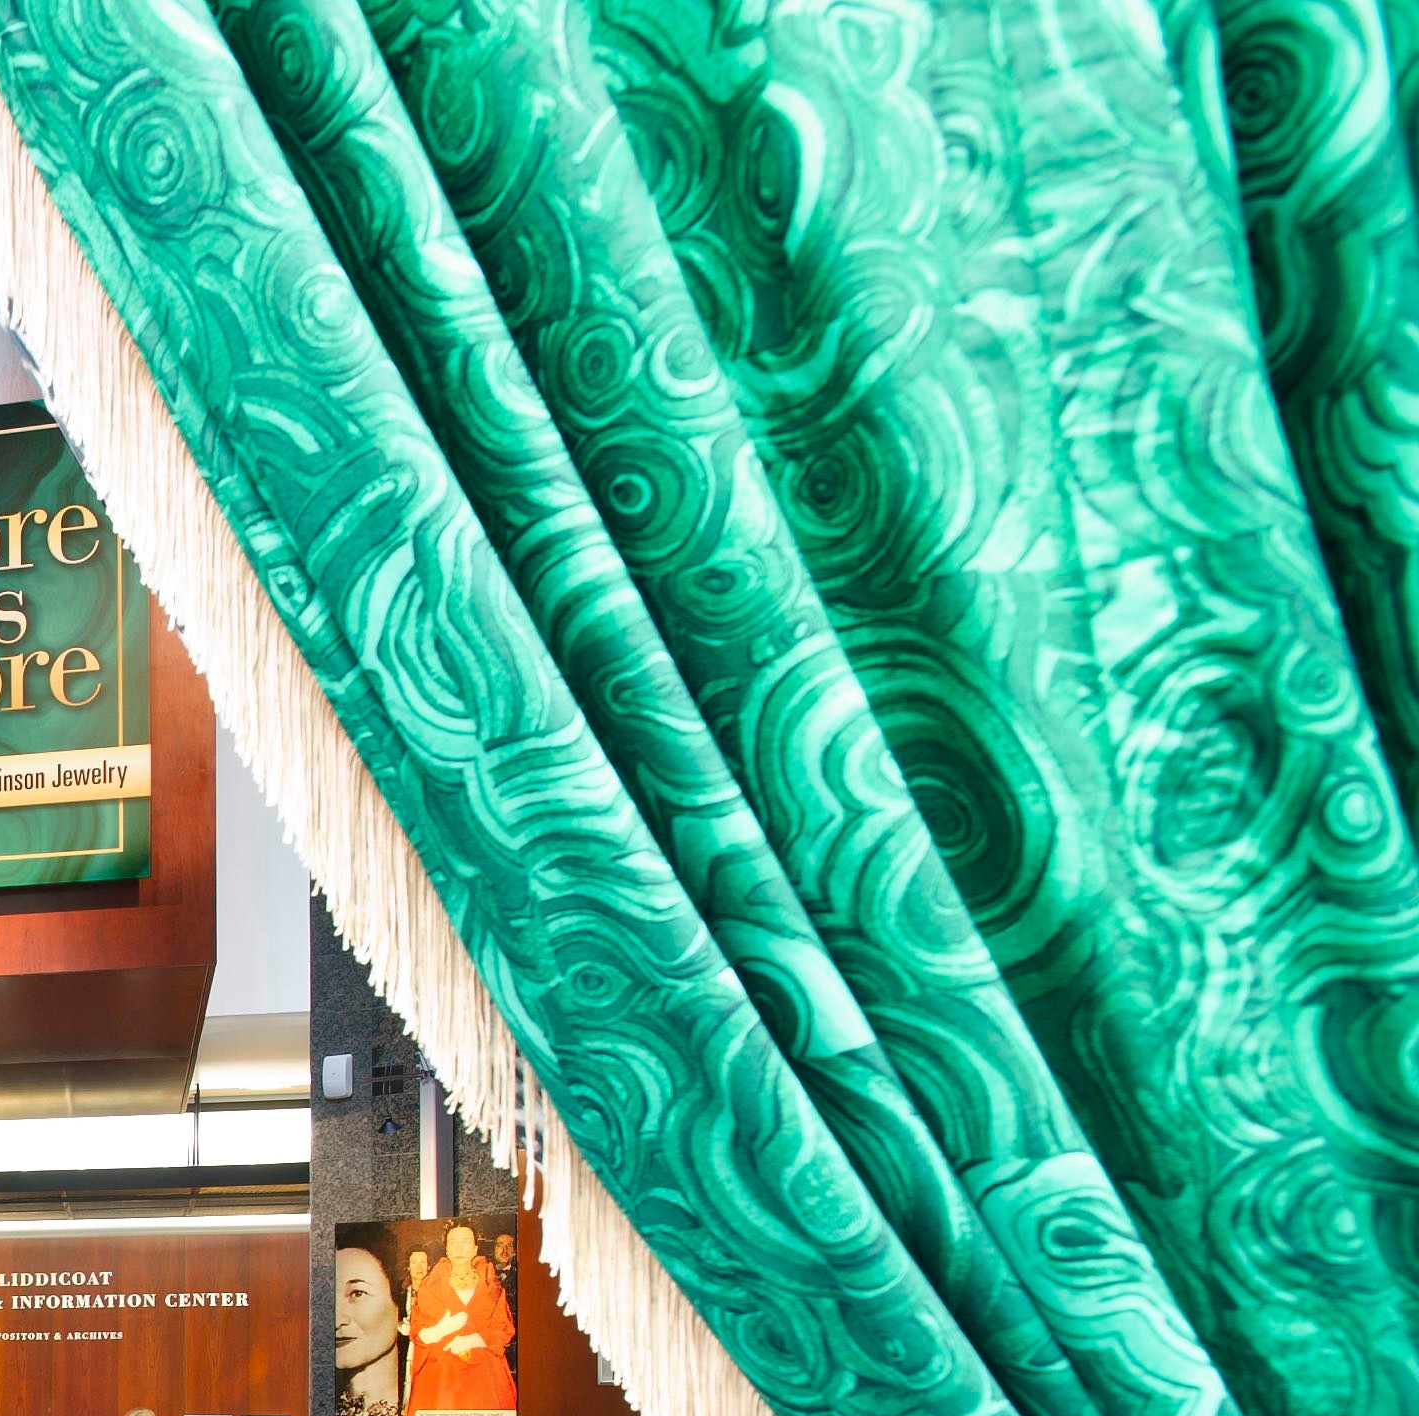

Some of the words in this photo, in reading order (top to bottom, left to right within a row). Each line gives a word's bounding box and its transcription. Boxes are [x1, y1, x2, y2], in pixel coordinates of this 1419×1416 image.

[52, 759, 128, 789] Jewelry
[11, 1293, 157, 1310] INFORMATION
[164, 1292, 249, 1308] CENTER
[53, 1333, 62, 1341] &
[66, 1331, 124, 1340] ARCHIVES
